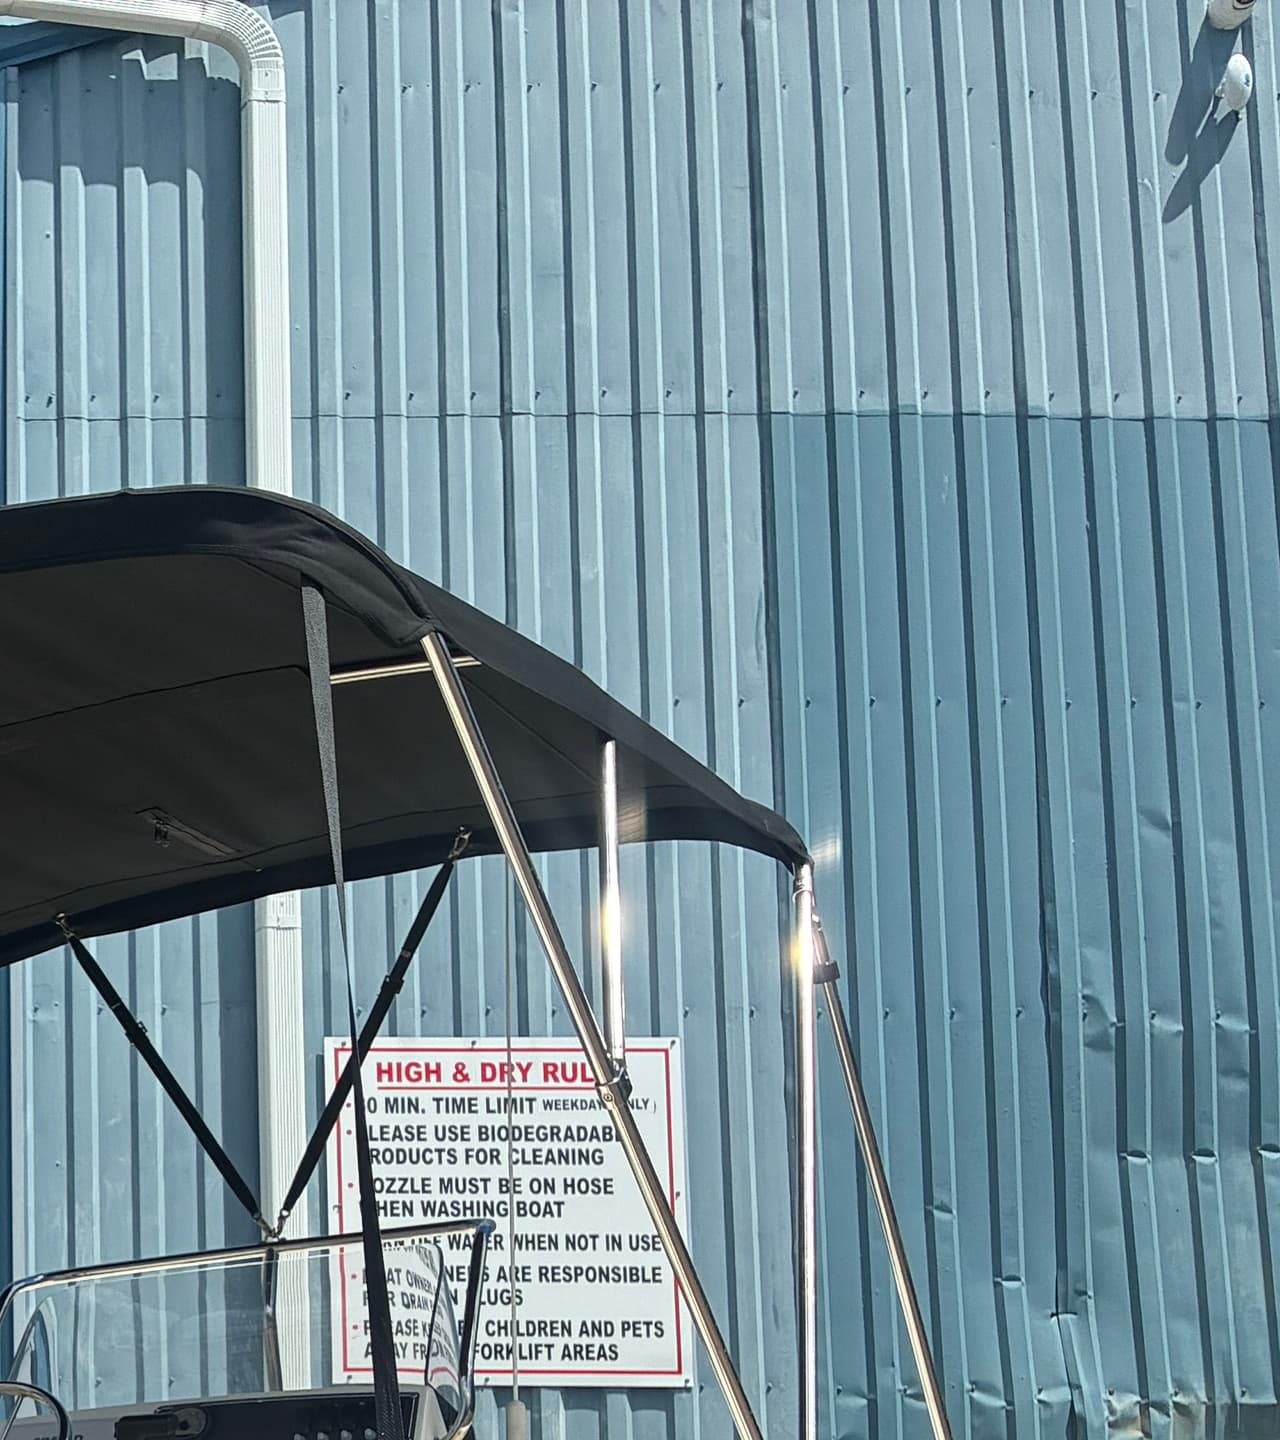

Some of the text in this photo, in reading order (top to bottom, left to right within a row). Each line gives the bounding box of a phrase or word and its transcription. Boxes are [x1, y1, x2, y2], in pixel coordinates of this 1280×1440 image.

[376, 1062, 597, 1083] HIGH & DRY RUL
[366, 1097, 378, 1114] 0
[384, 1097, 426, 1114] MIN.
[432, 1097, 479, 1114] TIME
[486, 1097, 537, 1114] LIMIT
[542, 1099, 603, 1111] WEEKDAY
[626, 1098, 650, 1110] NLY
[369, 1125, 621, 1142] LEASE USE BIODEGRADABL
[370, 1148, 604, 1165] RODUCTS FOR CLEANING
[373, 1177, 614, 1195] OZZLE MUST BE ON HOSE
[376, 1200, 565, 1218] HEN WASHING BOAT
[448, 1233, 505, 1251] WAER
[514, 1234, 559, 1251] WHEN
[565, 1234, 599, 1251] NOT
[605, 1234, 622, 1251] IN
[628, 1234, 662, 1251] USE
[496, 1266, 532, 1283] ARE
[538, 1266, 663, 1283] RESPONSIBLE
[485, 1320, 572, 1337] CHILDREN
[578, 1320, 614, 1337] AND
[621, 1321, 665, 1338] PETS
[561, 1344, 619, 1361] AREAS
